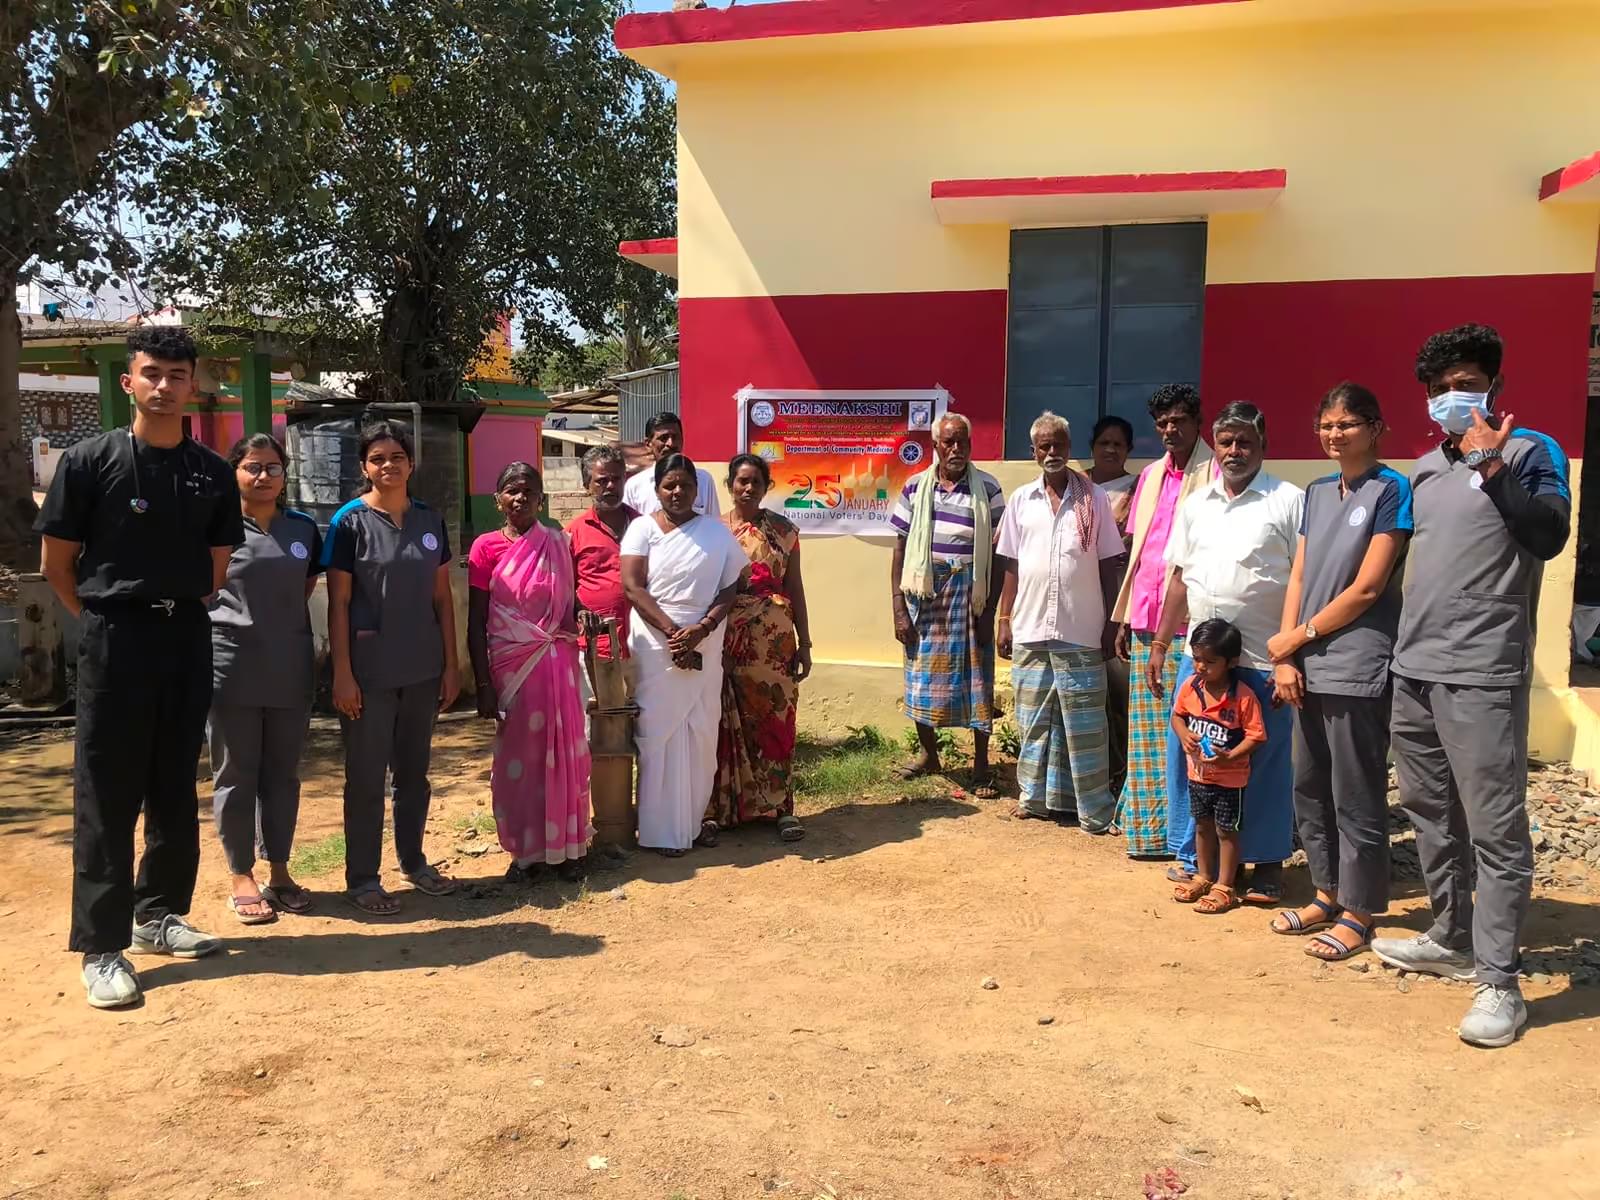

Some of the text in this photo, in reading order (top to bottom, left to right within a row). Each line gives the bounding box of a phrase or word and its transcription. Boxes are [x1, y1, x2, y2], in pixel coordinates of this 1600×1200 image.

[778, 401, 902, 416] MEENAKSHI
[786, 445, 893, 455] Department of Community Medicine
[784, 474, 889, 511] 25 JANUARY
[784, 510, 888, 522] National Voters' Day
